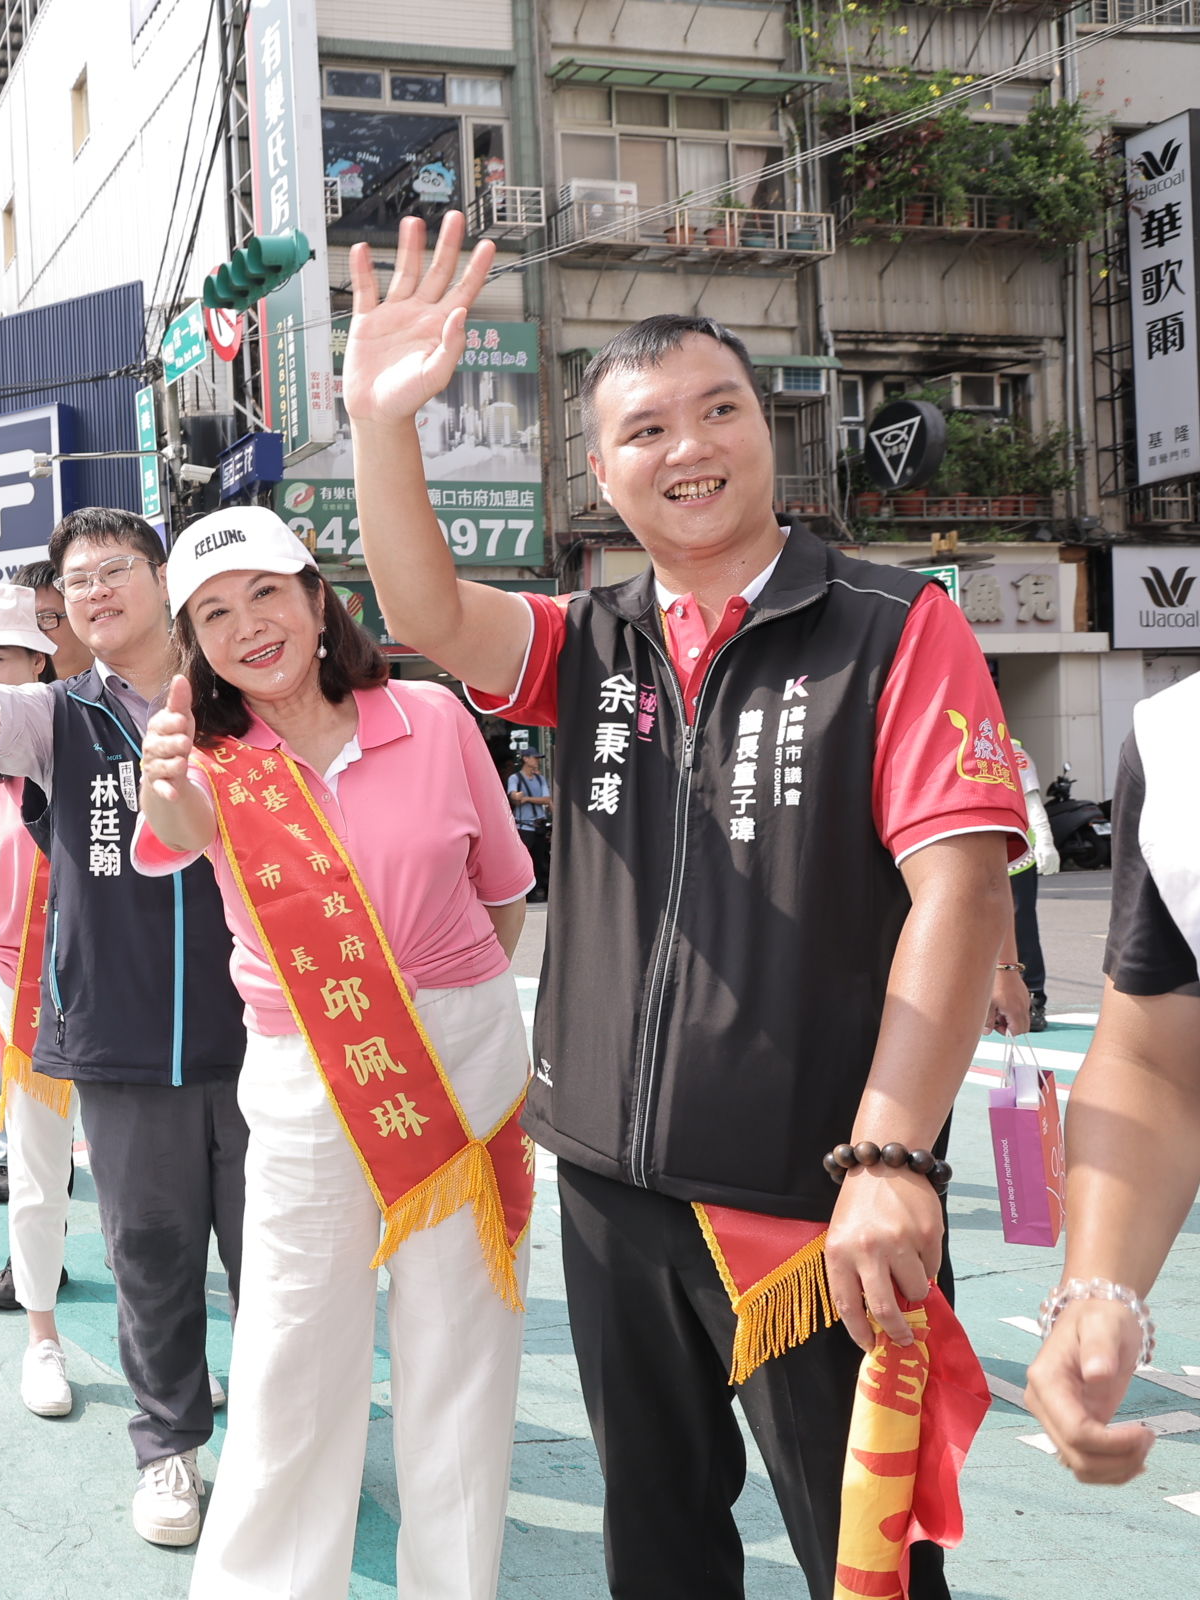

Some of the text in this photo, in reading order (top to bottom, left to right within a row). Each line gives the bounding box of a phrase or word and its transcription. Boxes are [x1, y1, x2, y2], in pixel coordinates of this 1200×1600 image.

[260, 20, 290, 235] 有巢氏房
[1140, 200, 1187, 362] 華歌爾
[457, 350, 529, 367] 等老闆加薪
[1147, 424, 1191, 450] 基隆
[194, 528, 247, 560] KEELUNG
[1138, 609, 1200, 628] Wacoal
[729, 708, 764, 843] 議長童子瑋
[774, 746, 783, 766] CITY
[784, 704, 808, 807] 基隆市議會
[773, 768, 783, 808] COUNCIL
[88, 774, 121, 877] 林廷翰
[319, 976, 431, 1141] 邱佩琳
[1001, 1138, 1012, 1177] motherhood.
